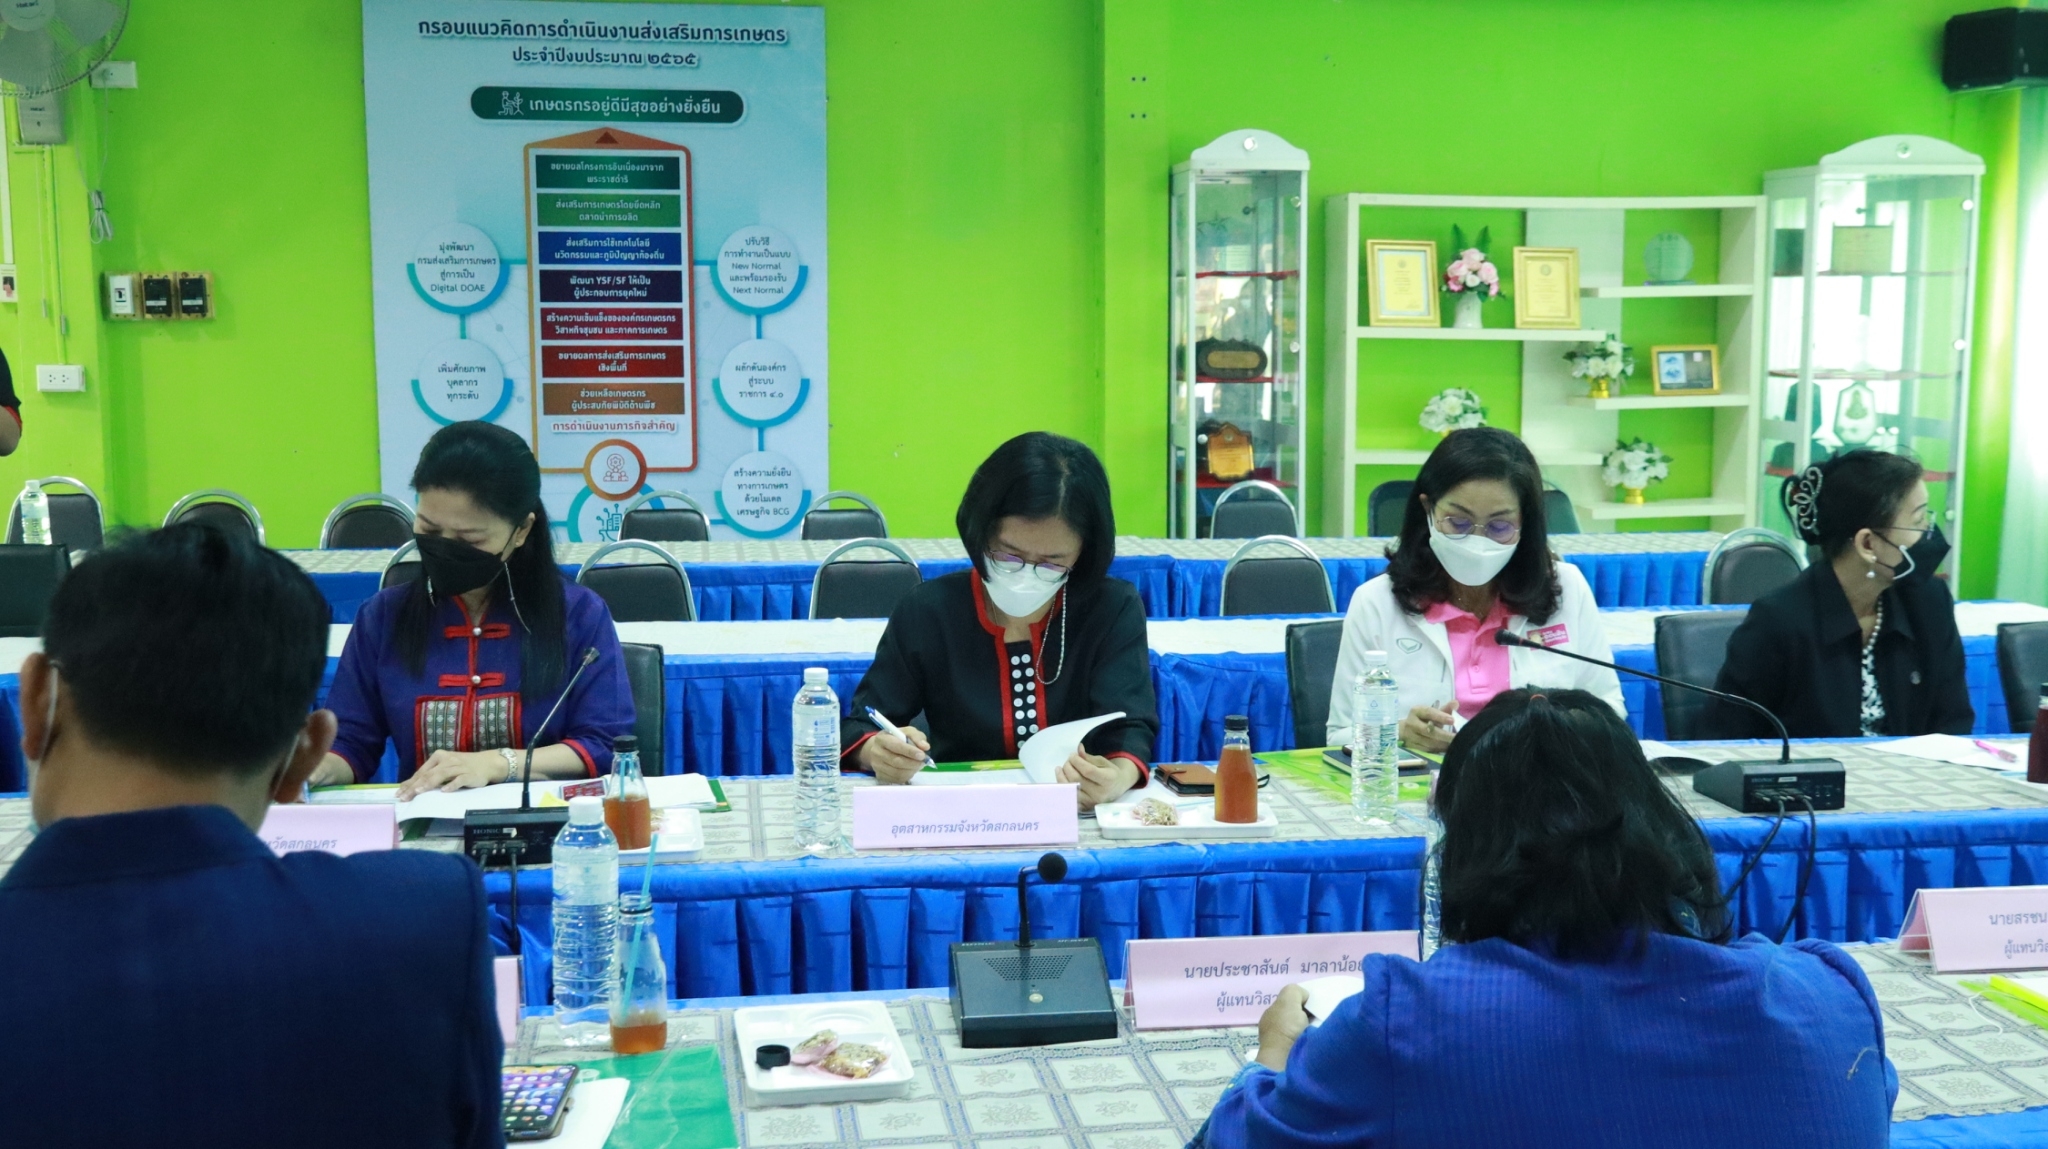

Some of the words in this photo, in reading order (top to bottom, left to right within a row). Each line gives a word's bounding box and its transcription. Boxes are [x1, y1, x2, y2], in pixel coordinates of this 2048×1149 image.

[418, 17, 787, 43] กรอบแนวคิดการดำเนินงานส่งเสริมการเกษตร
[512, 46, 643, 65] ประจำปีงบประมาณ
[648, 51, 697, 66] ๒๕๖๕
[529, 95, 721, 119] เกษตรกรอยู่ดีมีสุขอย่างยั่งยืน
[550, 161, 664, 172] ขยายผลโครงการอันเนื่องมาจาก
[587, 175, 629, 184] พระราชดำริ
[555, 199, 661, 209] ส่งเสริมการเกษตรโดยยึดหลัก
[579, 212, 638, 221] ตลาดนำการผลิต
[566, 237, 650, 247] ส่งเสริมการใช้เทคโนโลยี
[439, 242, 475, 254] มุ่งพัฒนา
[724, 248, 791, 258] การทำงานเป็นแบบ
[417, 256, 497, 265] กรมส่งเสริมการเกษตร
[554, 249, 665, 261] นวัตกรรมและภูมิปัญญาท้องถิ่น
[751, 262, 781, 270] Normal
[440, 269, 475, 281] สู่การเป็น
[570, 275, 594, 285] พัฒนา
[596, 275, 626, 285] YSF/SF
[628, 274, 651, 285] ให้เป็น
[730, 272, 787, 283] และพร้อมรองรับ
[430, 283, 458, 294] Digital
[461, 284, 486, 292] DOAE
[574, 287, 648, 299] ผู้ประกอบการยุคใหม่
[733, 286, 752, 294] Next
[754, 286, 784, 294] Normal
[555, 325, 602, 336] วิสาหกิจชุมชน
[605, 326, 668, 334] และภาคการเกษตร
[558, 350, 666, 360] ขยายผลการส่งเสริมการเกษตร
[438, 362, 486, 373] เพิ่มศักยภาพ
[735, 361, 786, 372] ผลักดันองค์กร
[446, 379, 478, 389] บุคลากร
[748, 376, 774, 388] สู่ระบบ
[446, 391, 479, 402] ทุกระดับ
[580, 387, 647, 398] ช่วยเหลือเกษตรกร
[739, 390, 767, 398] ราชการ
[552, 420, 676, 432] การดำเนินงานภารกิจสำคัญ
[734, 465, 792, 477] สร้างความยั่งยืน
[737, 482, 789, 490] ทางการเกษตร
[744, 493, 782, 503] ด้วยโมเดล
[736, 506, 770, 518] เศรษฐกิจ
[891, 819, 1040, 838] อุตสาหกรรมจังหวัดสกลนคร
[1184, 957, 1291, 979] นายประชาสันต์
